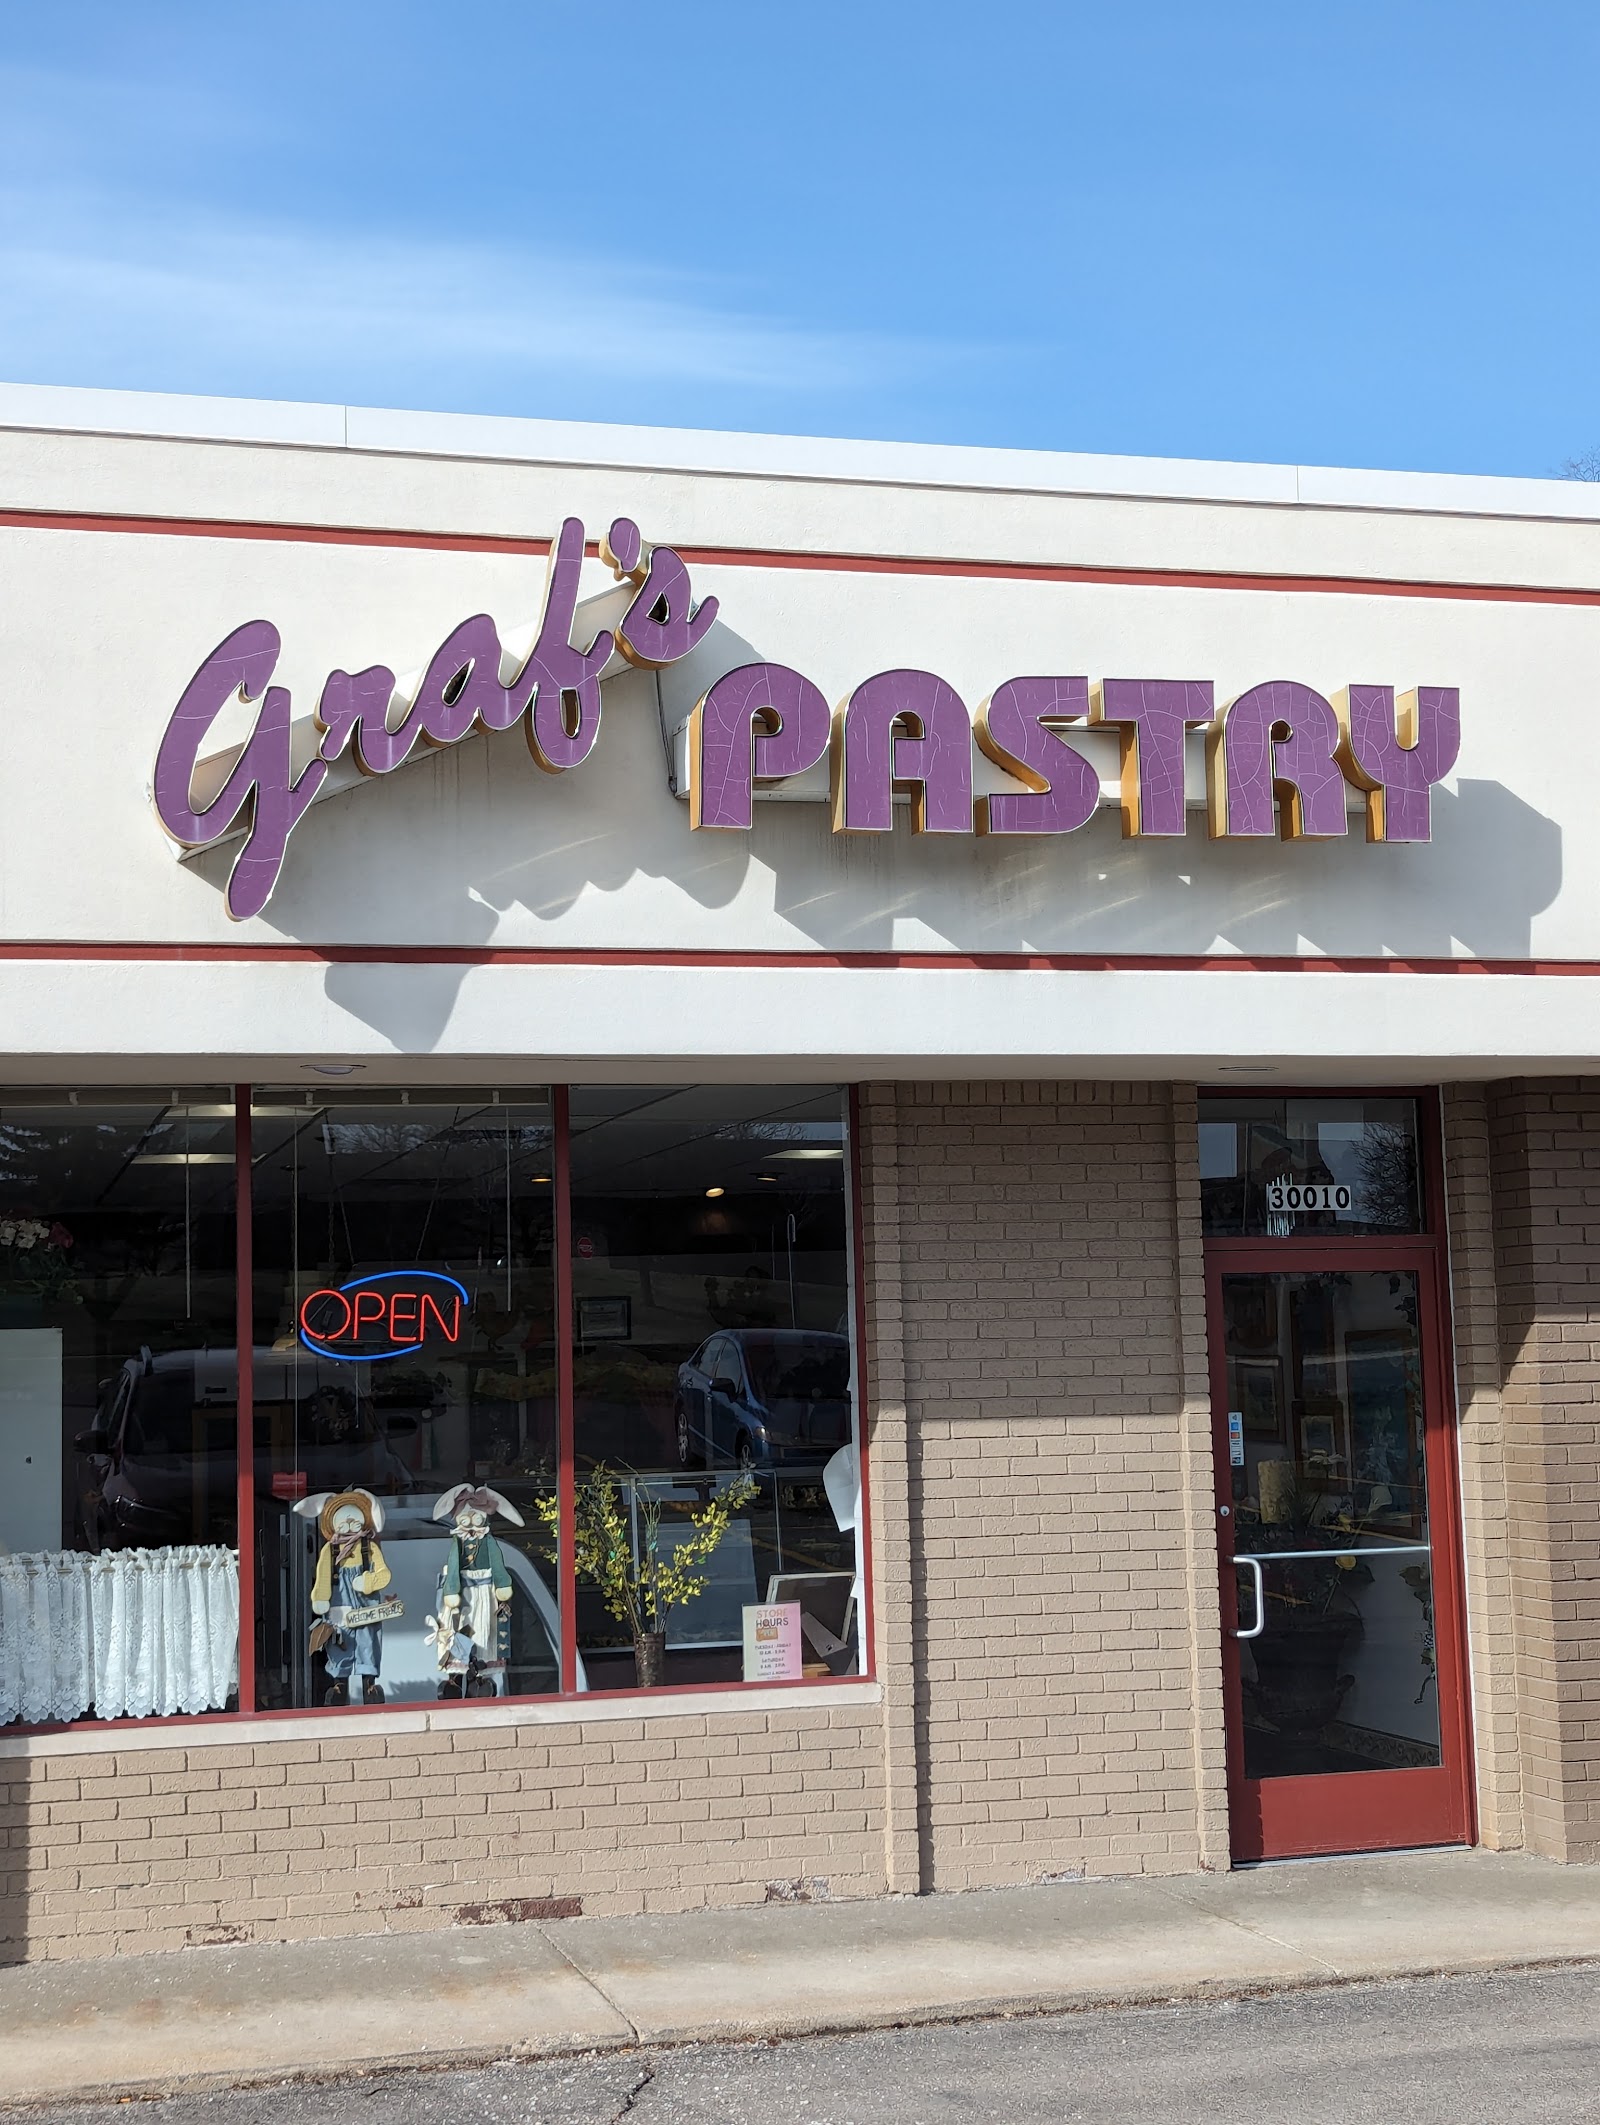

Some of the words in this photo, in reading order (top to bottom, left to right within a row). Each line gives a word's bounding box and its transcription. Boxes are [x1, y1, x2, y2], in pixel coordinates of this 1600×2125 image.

[689, 661, 1461, 843] PASTRY
[1270, 1186, 1351, 1210] 30010
[300, 1288, 462, 1343] OPEN
[347, 1610, 377, 1624] WELCOME
[755, 1617, 788, 1627] HOURS
[756, 1608, 788, 1618] STORE
